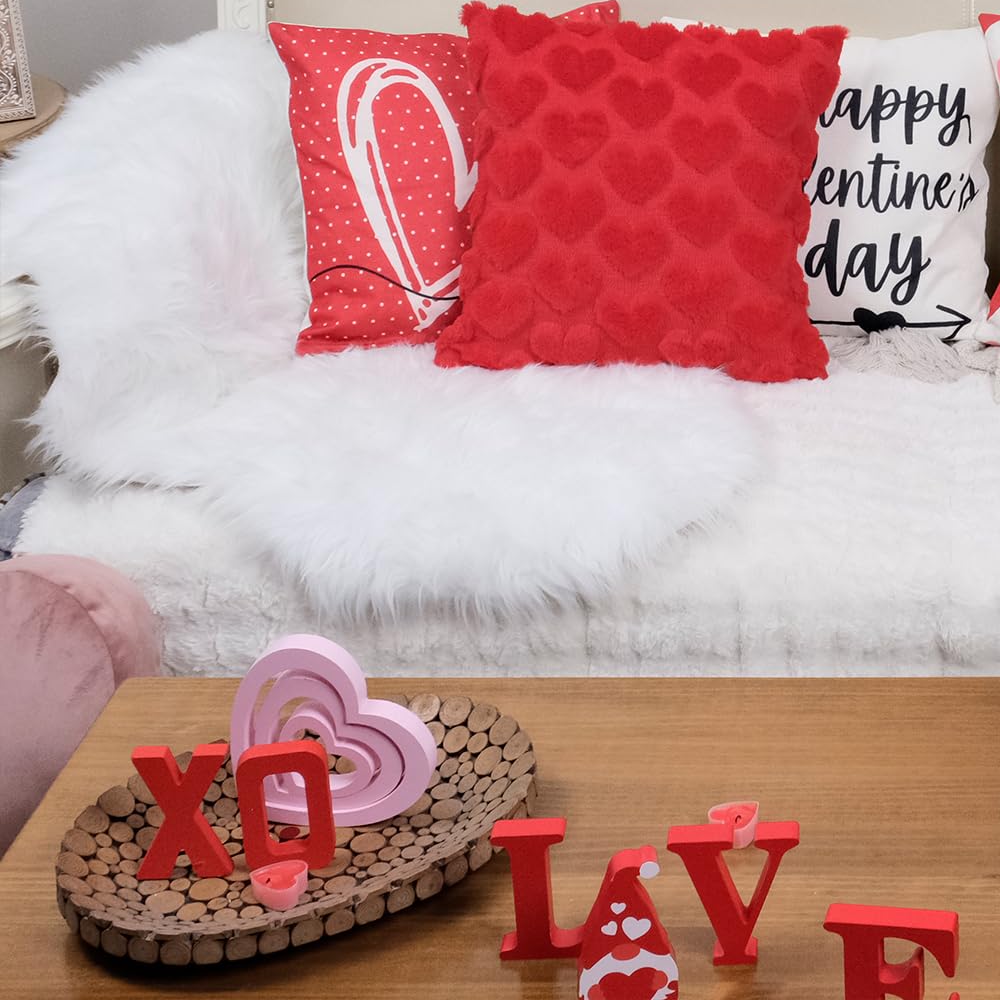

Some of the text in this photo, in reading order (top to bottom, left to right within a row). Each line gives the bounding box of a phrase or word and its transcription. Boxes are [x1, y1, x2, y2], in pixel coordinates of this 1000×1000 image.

[818, 83, 972, 147] appy
[802, 153, 979, 213] entine's
[804, 218, 932, 305] day
[131, 740, 336, 880] XO
